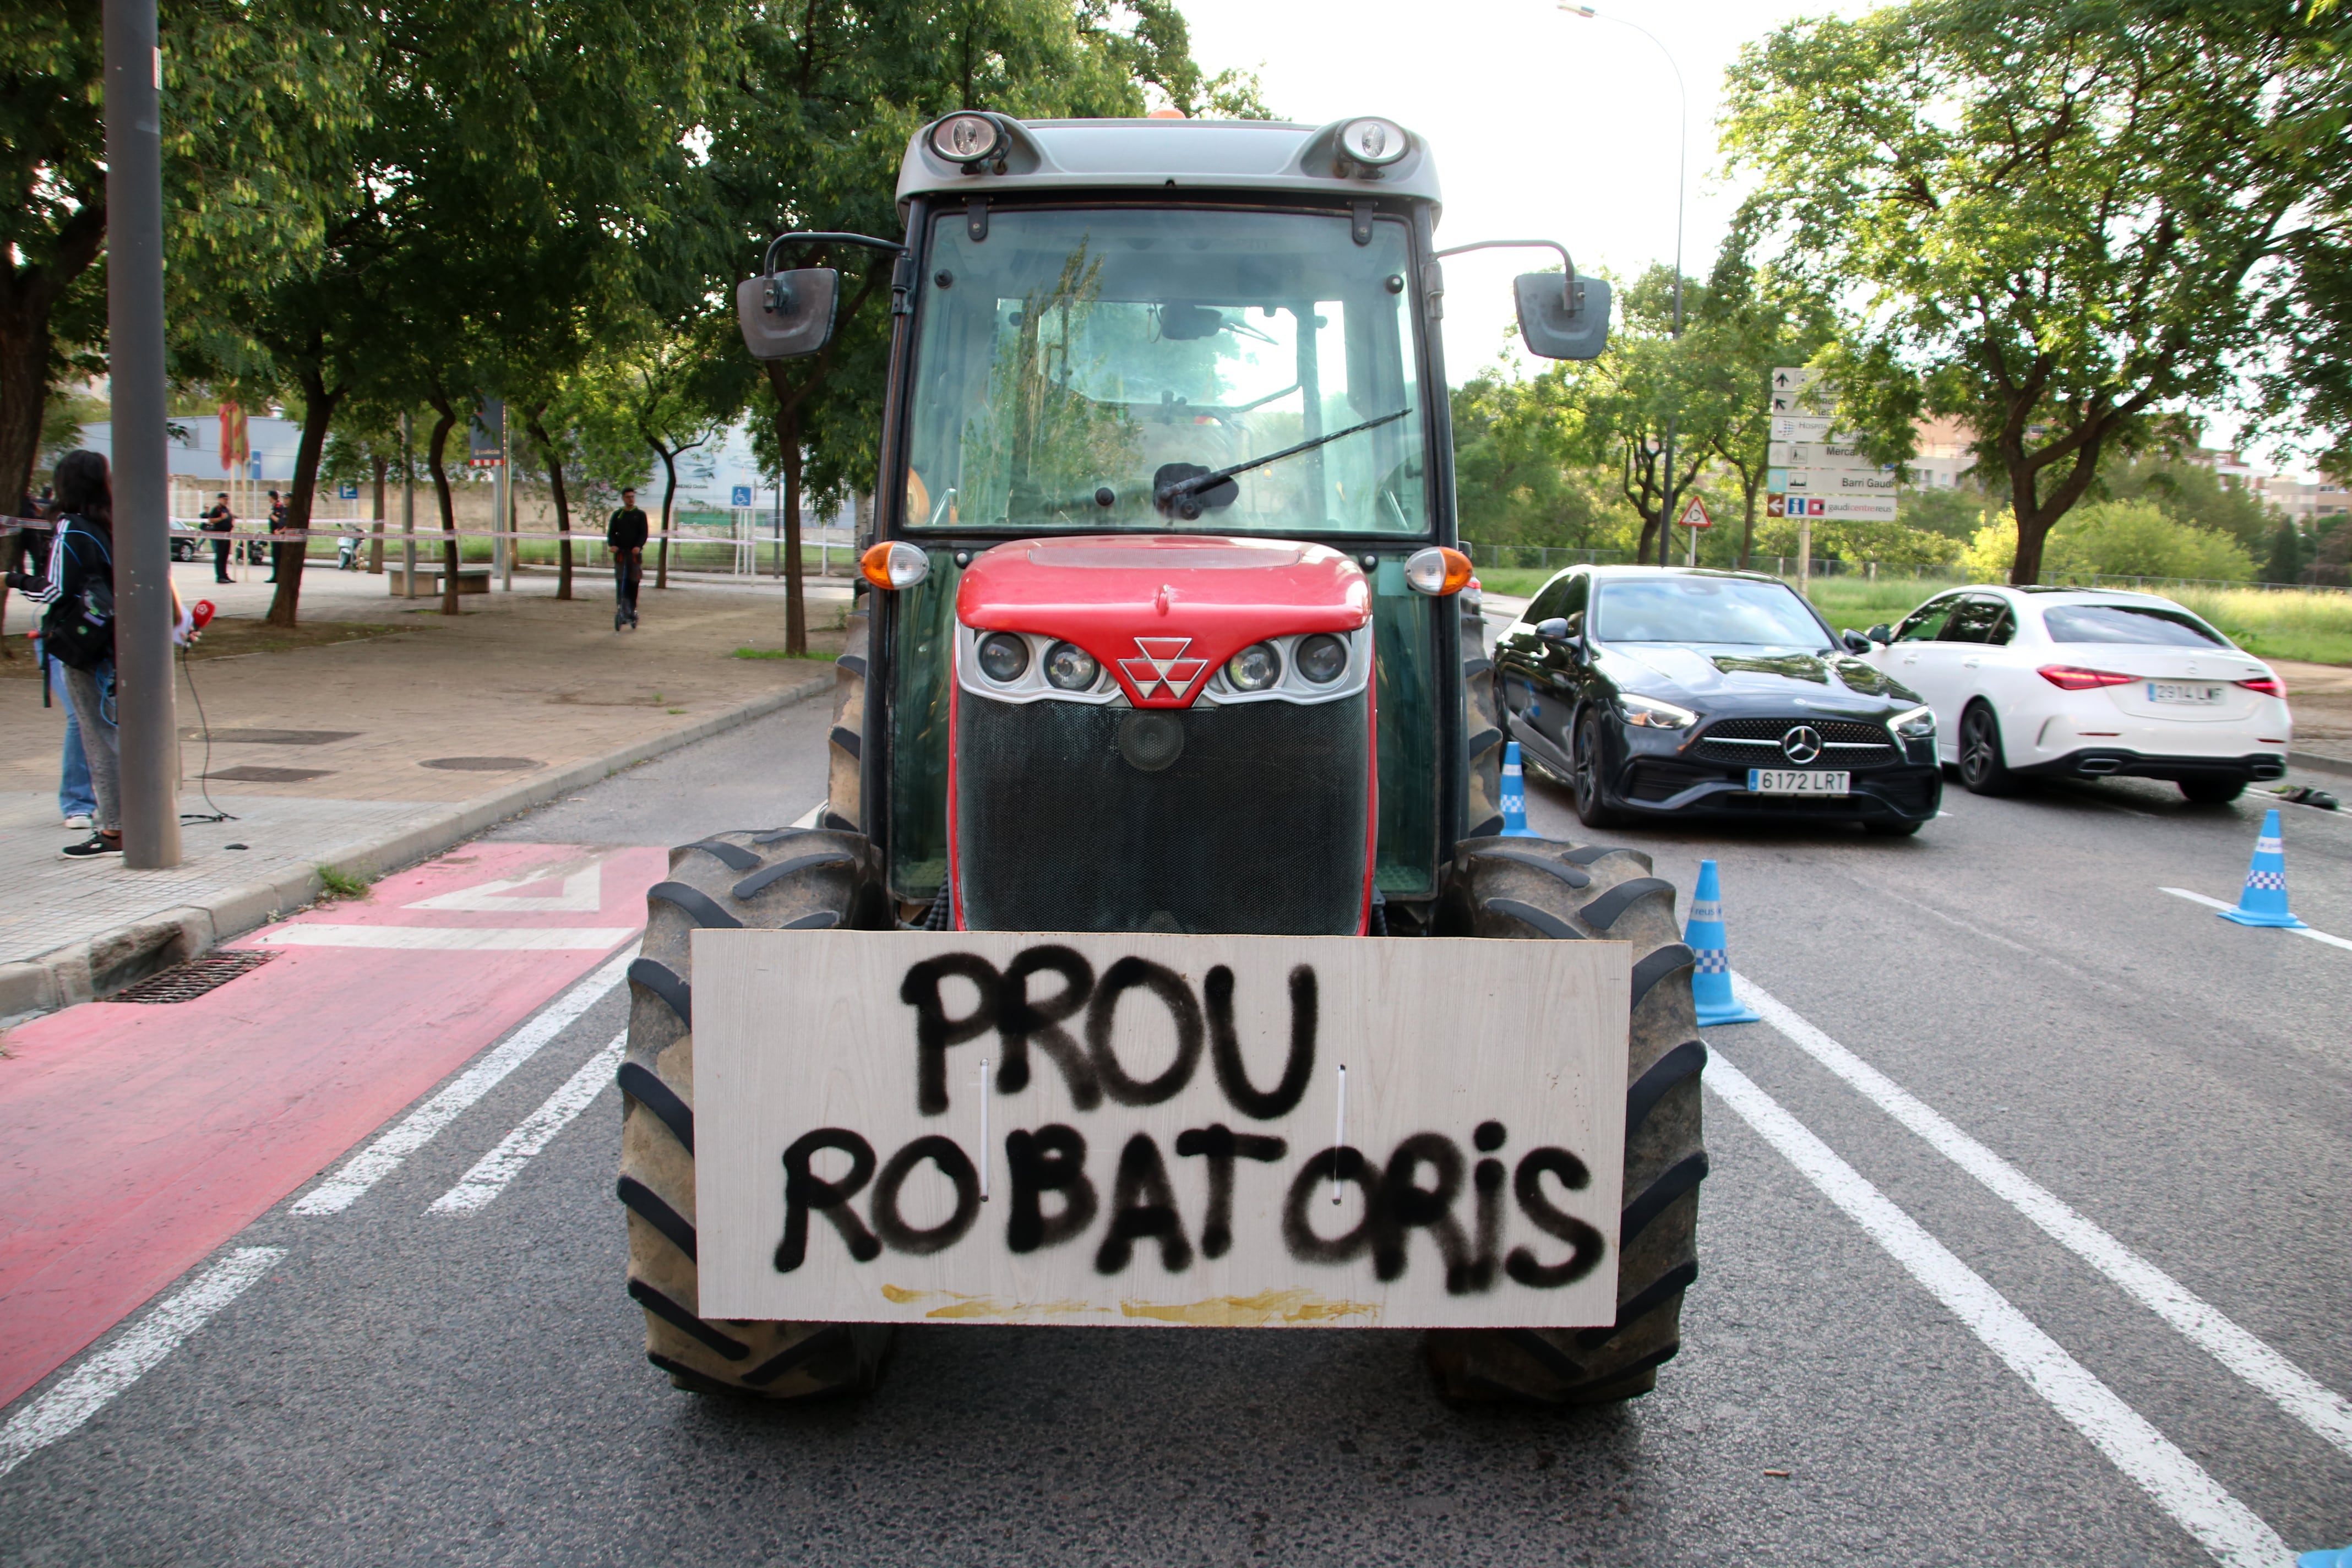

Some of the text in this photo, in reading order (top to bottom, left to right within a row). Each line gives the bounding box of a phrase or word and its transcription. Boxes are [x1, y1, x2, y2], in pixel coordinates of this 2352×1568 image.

[1827, 447, 1855, 456] Merca
[1842, 478, 1864, 487] Barri
[1763, 772, 1845, 790] 6172 LRT
[901, 944, 1319, 1119] PROU
